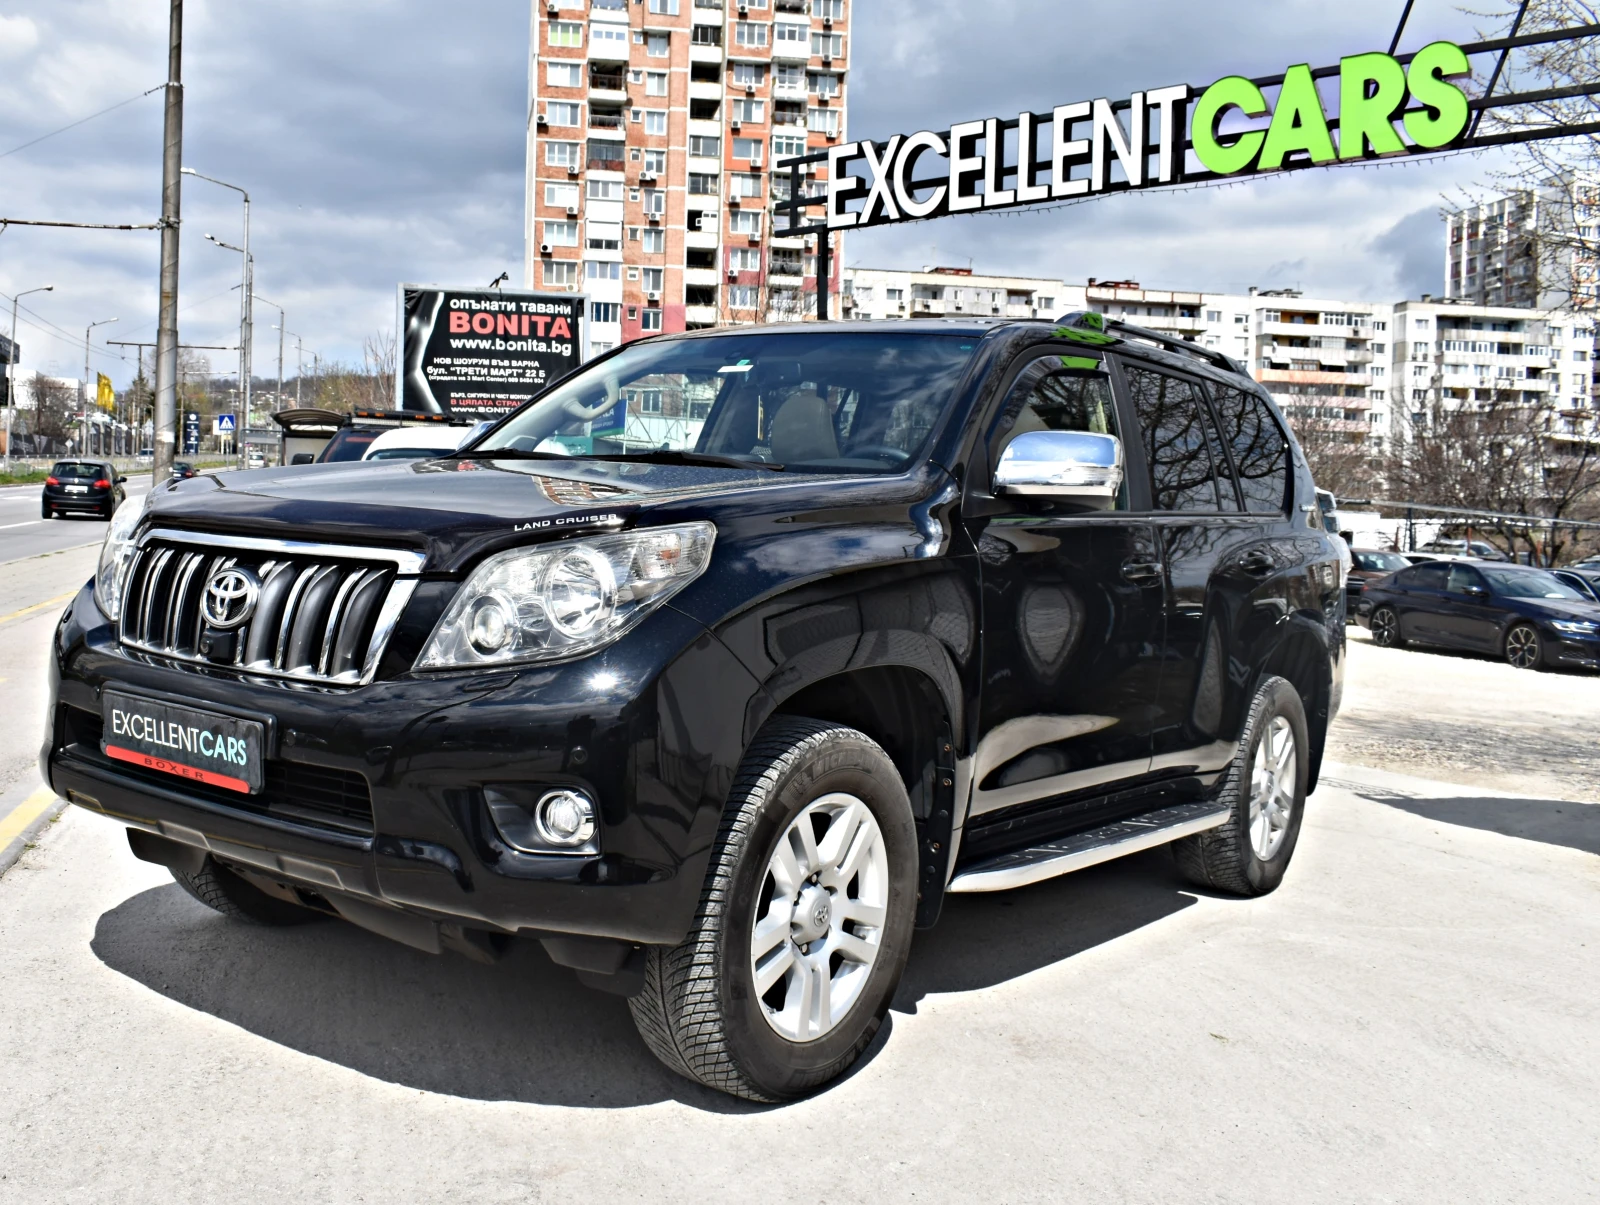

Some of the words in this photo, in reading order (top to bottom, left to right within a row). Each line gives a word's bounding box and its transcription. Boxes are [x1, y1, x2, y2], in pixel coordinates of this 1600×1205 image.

[449, 298, 516, 312] опънати
[520, 301, 572, 315] тавани
[449, 311, 572, 339] BONITA
[449, 338, 572, 357] www.bonita.bg
[426, 366, 448, 376] бул.
[525, 369, 537, 378] 22
[433, 357, 452, 365] НОВ
[453, 358, 490, 366] ШОУРУМ
[491, 359, 510, 367] ВЪВ
[511, 360, 540, 368] ВАРНА
[514, 520, 551, 532] LAND
[555, 513, 617, 525] CRUISER
[144, 757, 204, 780] BOXER
